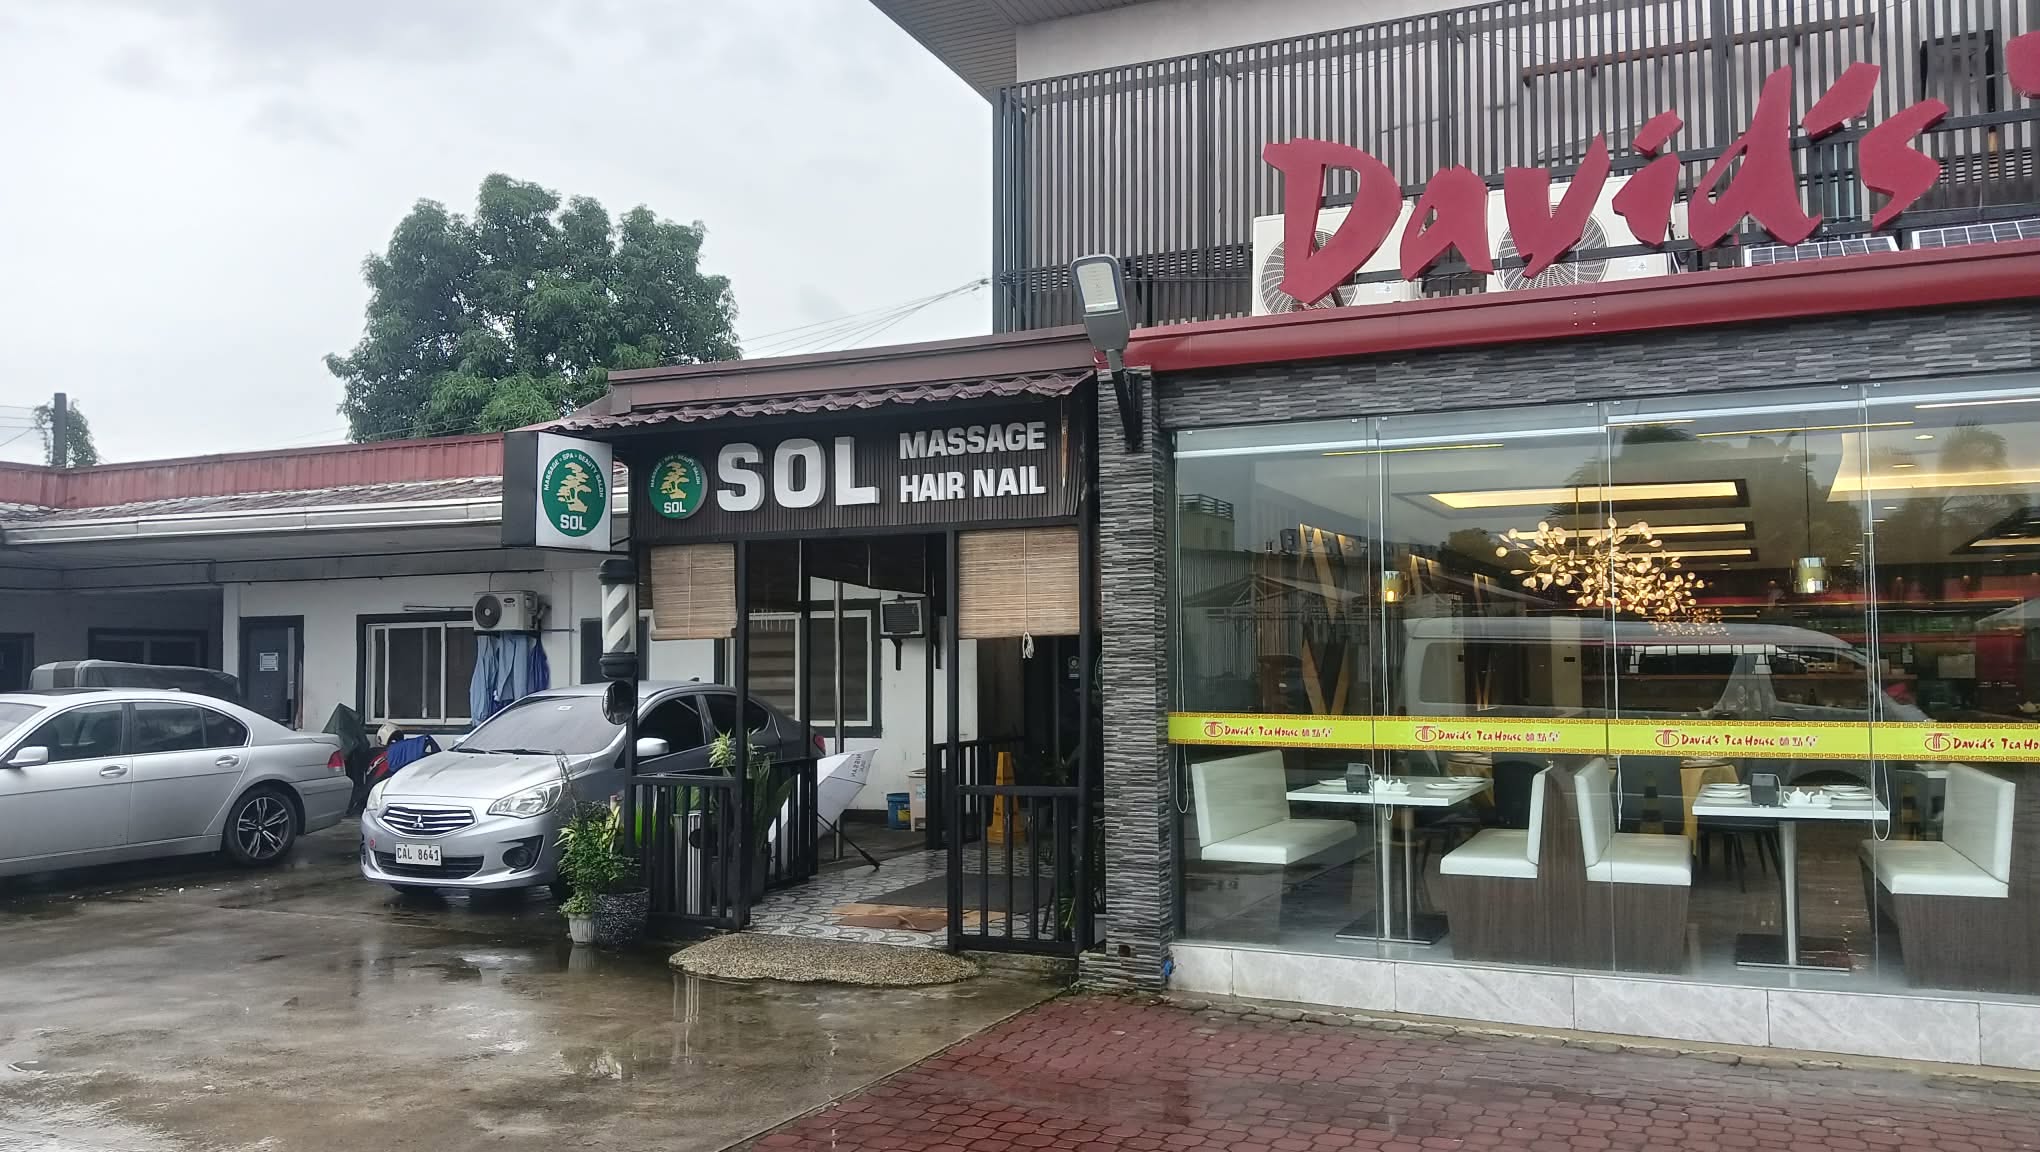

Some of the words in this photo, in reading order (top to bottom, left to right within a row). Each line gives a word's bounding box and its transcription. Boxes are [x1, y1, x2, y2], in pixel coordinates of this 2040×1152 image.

[1263, 61, 1948, 305] David's
[900, 421, 1046, 460] MASSAGE
[544, 459, 560, 490] MASSAGE
[562, 453, 574, 461] SPA
[578, 455, 598, 473] BEAUTY
[595, 474, 604, 498] SALON
[692, 466, 701, 485] SALON
[717, 436, 880, 512] SOL
[900, 470, 965, 503] HAIR
[973, 465, 1047, 498] NAIL
[663, 501, 687, 514] SOL
[559, 514, 587, 531] SOL
[1224, 725, 1254, 736] David's
[1438, 730, 1472, 740] David's
[1681, 734, 1719, 745] David's
[1953, 737, 1995, 750] David's
[397, 847, 412, 860] CAL
[417, 849, 439, 861] 8641
